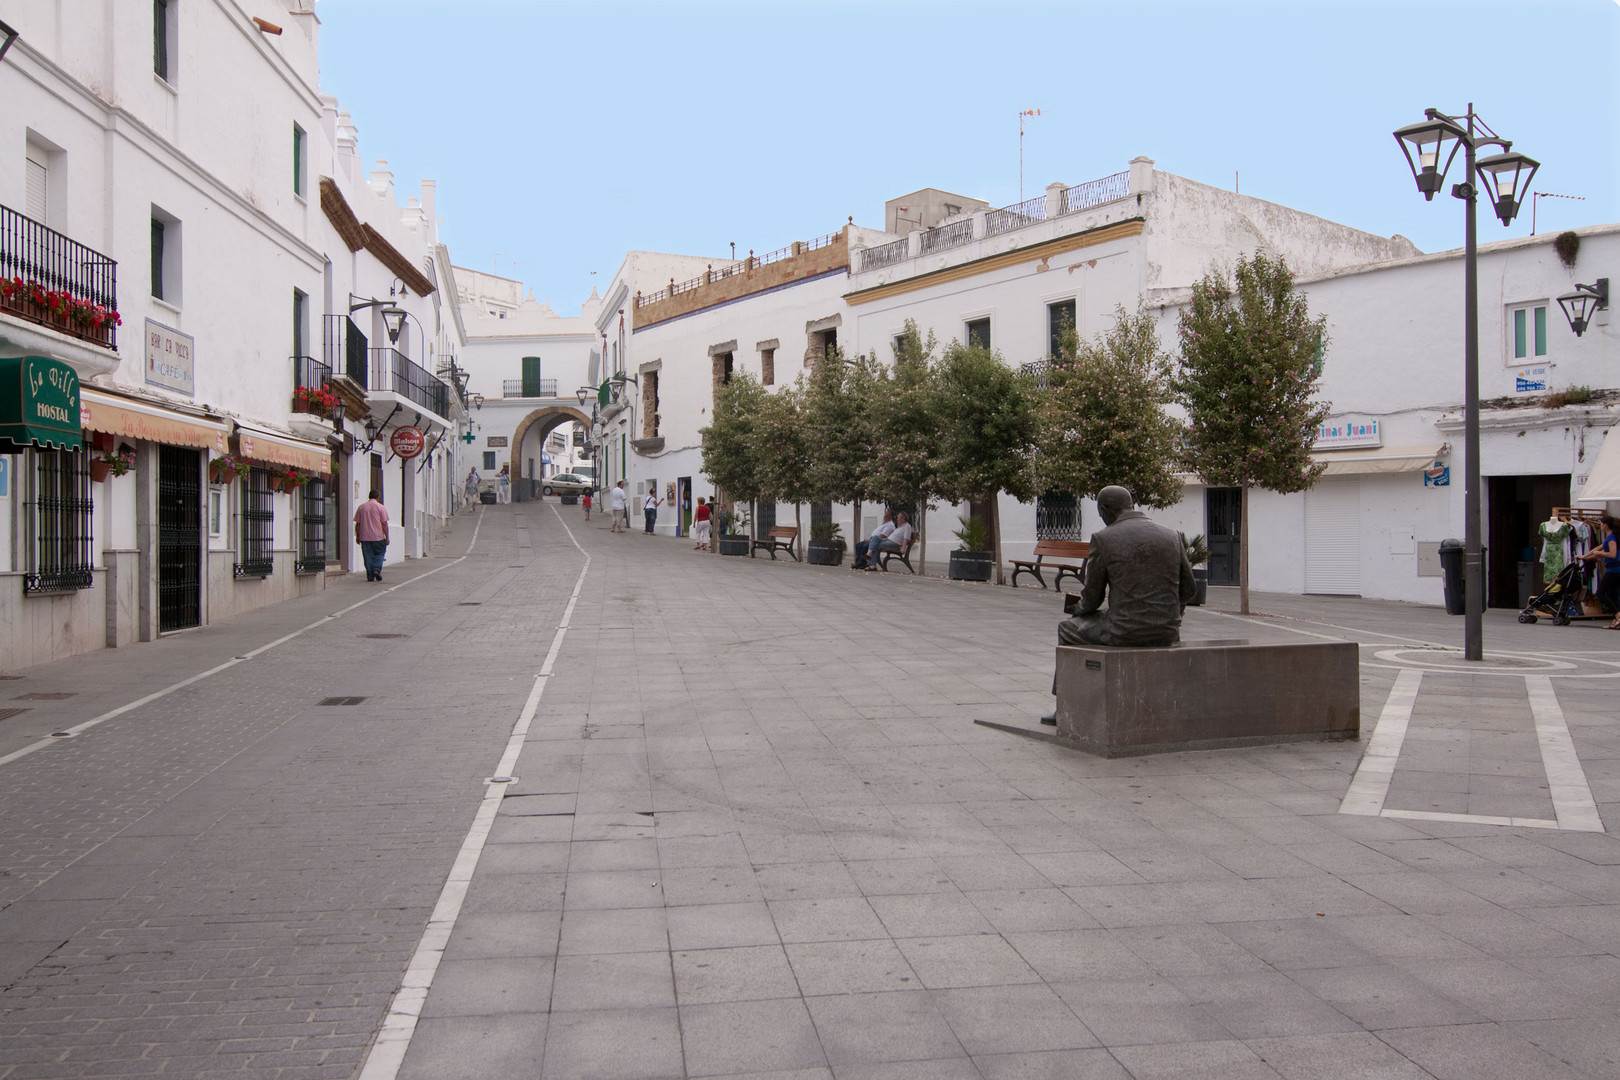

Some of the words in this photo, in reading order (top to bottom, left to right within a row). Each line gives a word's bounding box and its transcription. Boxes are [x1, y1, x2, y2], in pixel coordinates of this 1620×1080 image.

[151, 332, 161, 349] BAR
[165, 338, 172, 354] LA
[175, 341, 189, 360] VILLA
[29, 362, 43, 398] La
[49, 367, 75, 407] Villa
[37, 402, 70, 423] HOSTAL
[1346, 420, 1377, 437] Juani
